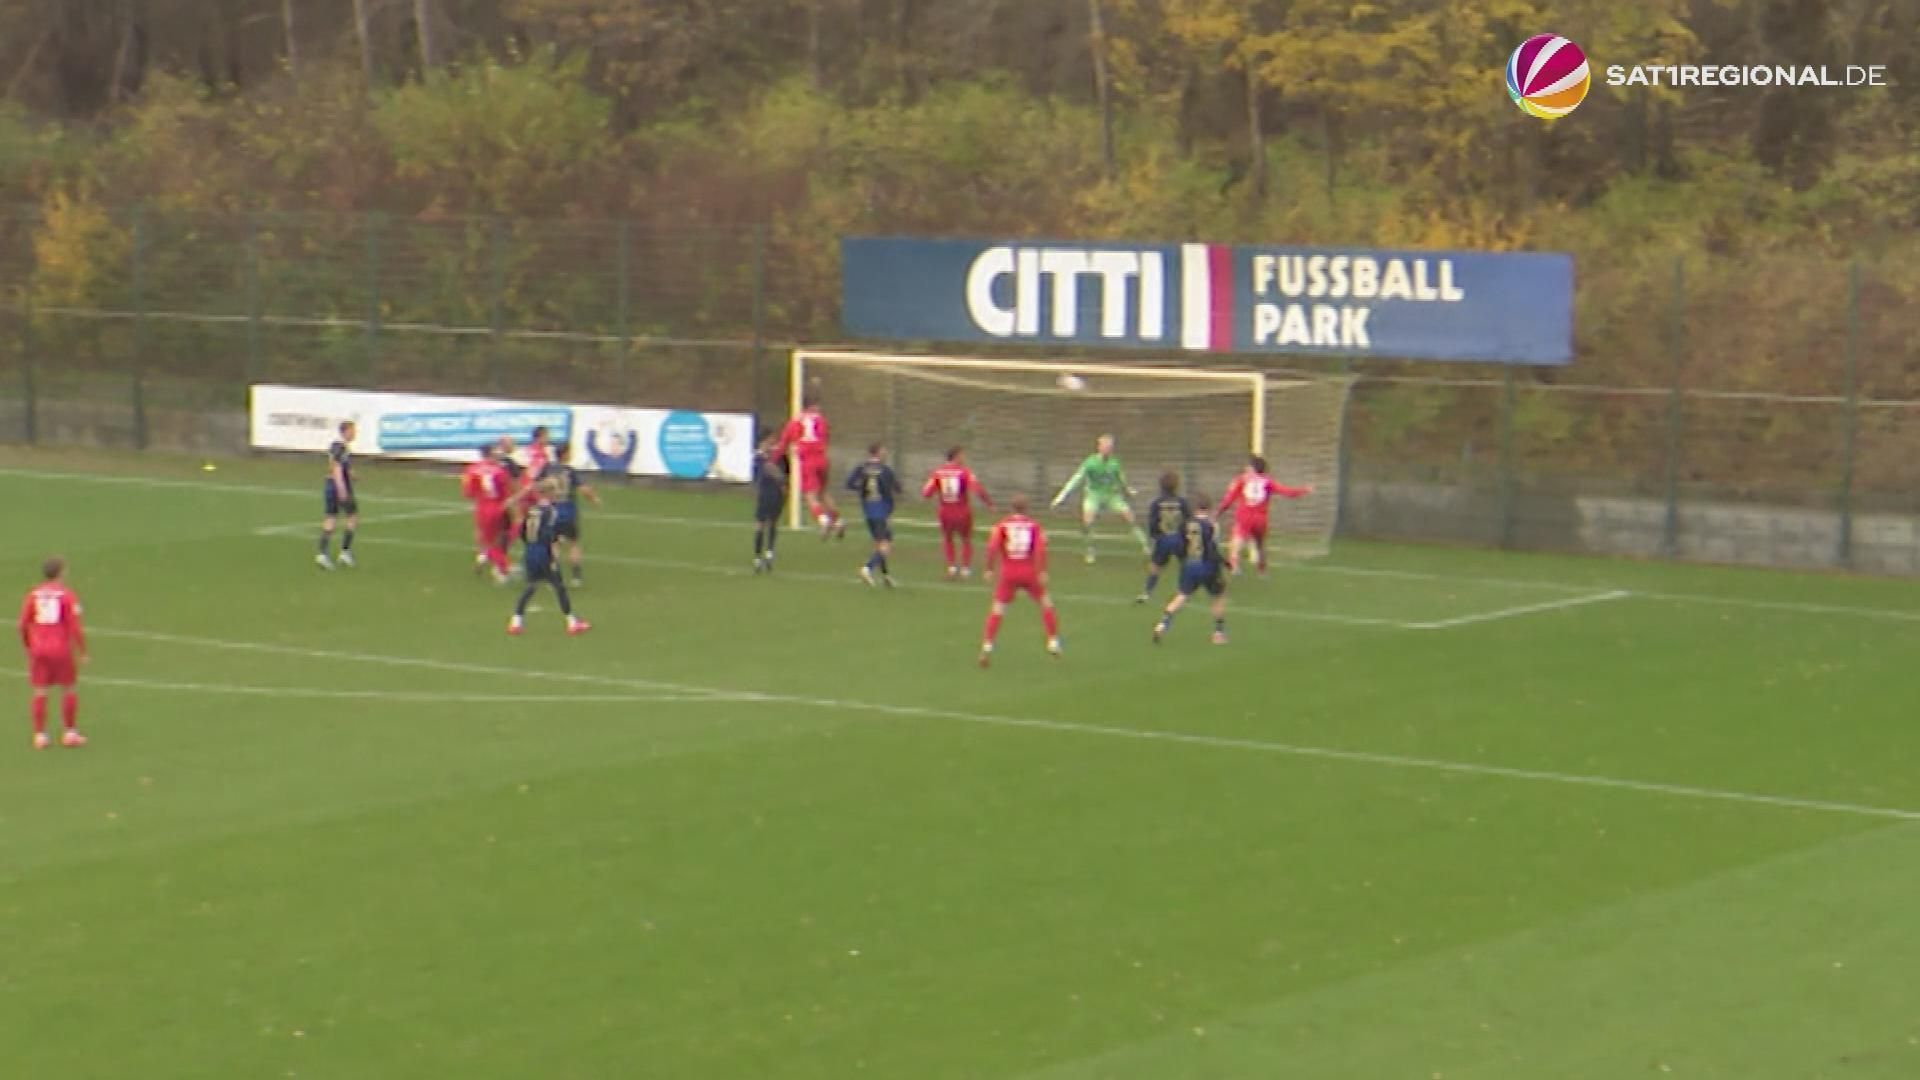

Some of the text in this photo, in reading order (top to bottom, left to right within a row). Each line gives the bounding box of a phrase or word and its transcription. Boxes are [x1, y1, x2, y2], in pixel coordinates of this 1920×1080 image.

[967, 247, 1163, 338] CITTI
[1254, 255, 1464, 301] FUSSBALL
[1254, 304, 1371, 348] PARK
